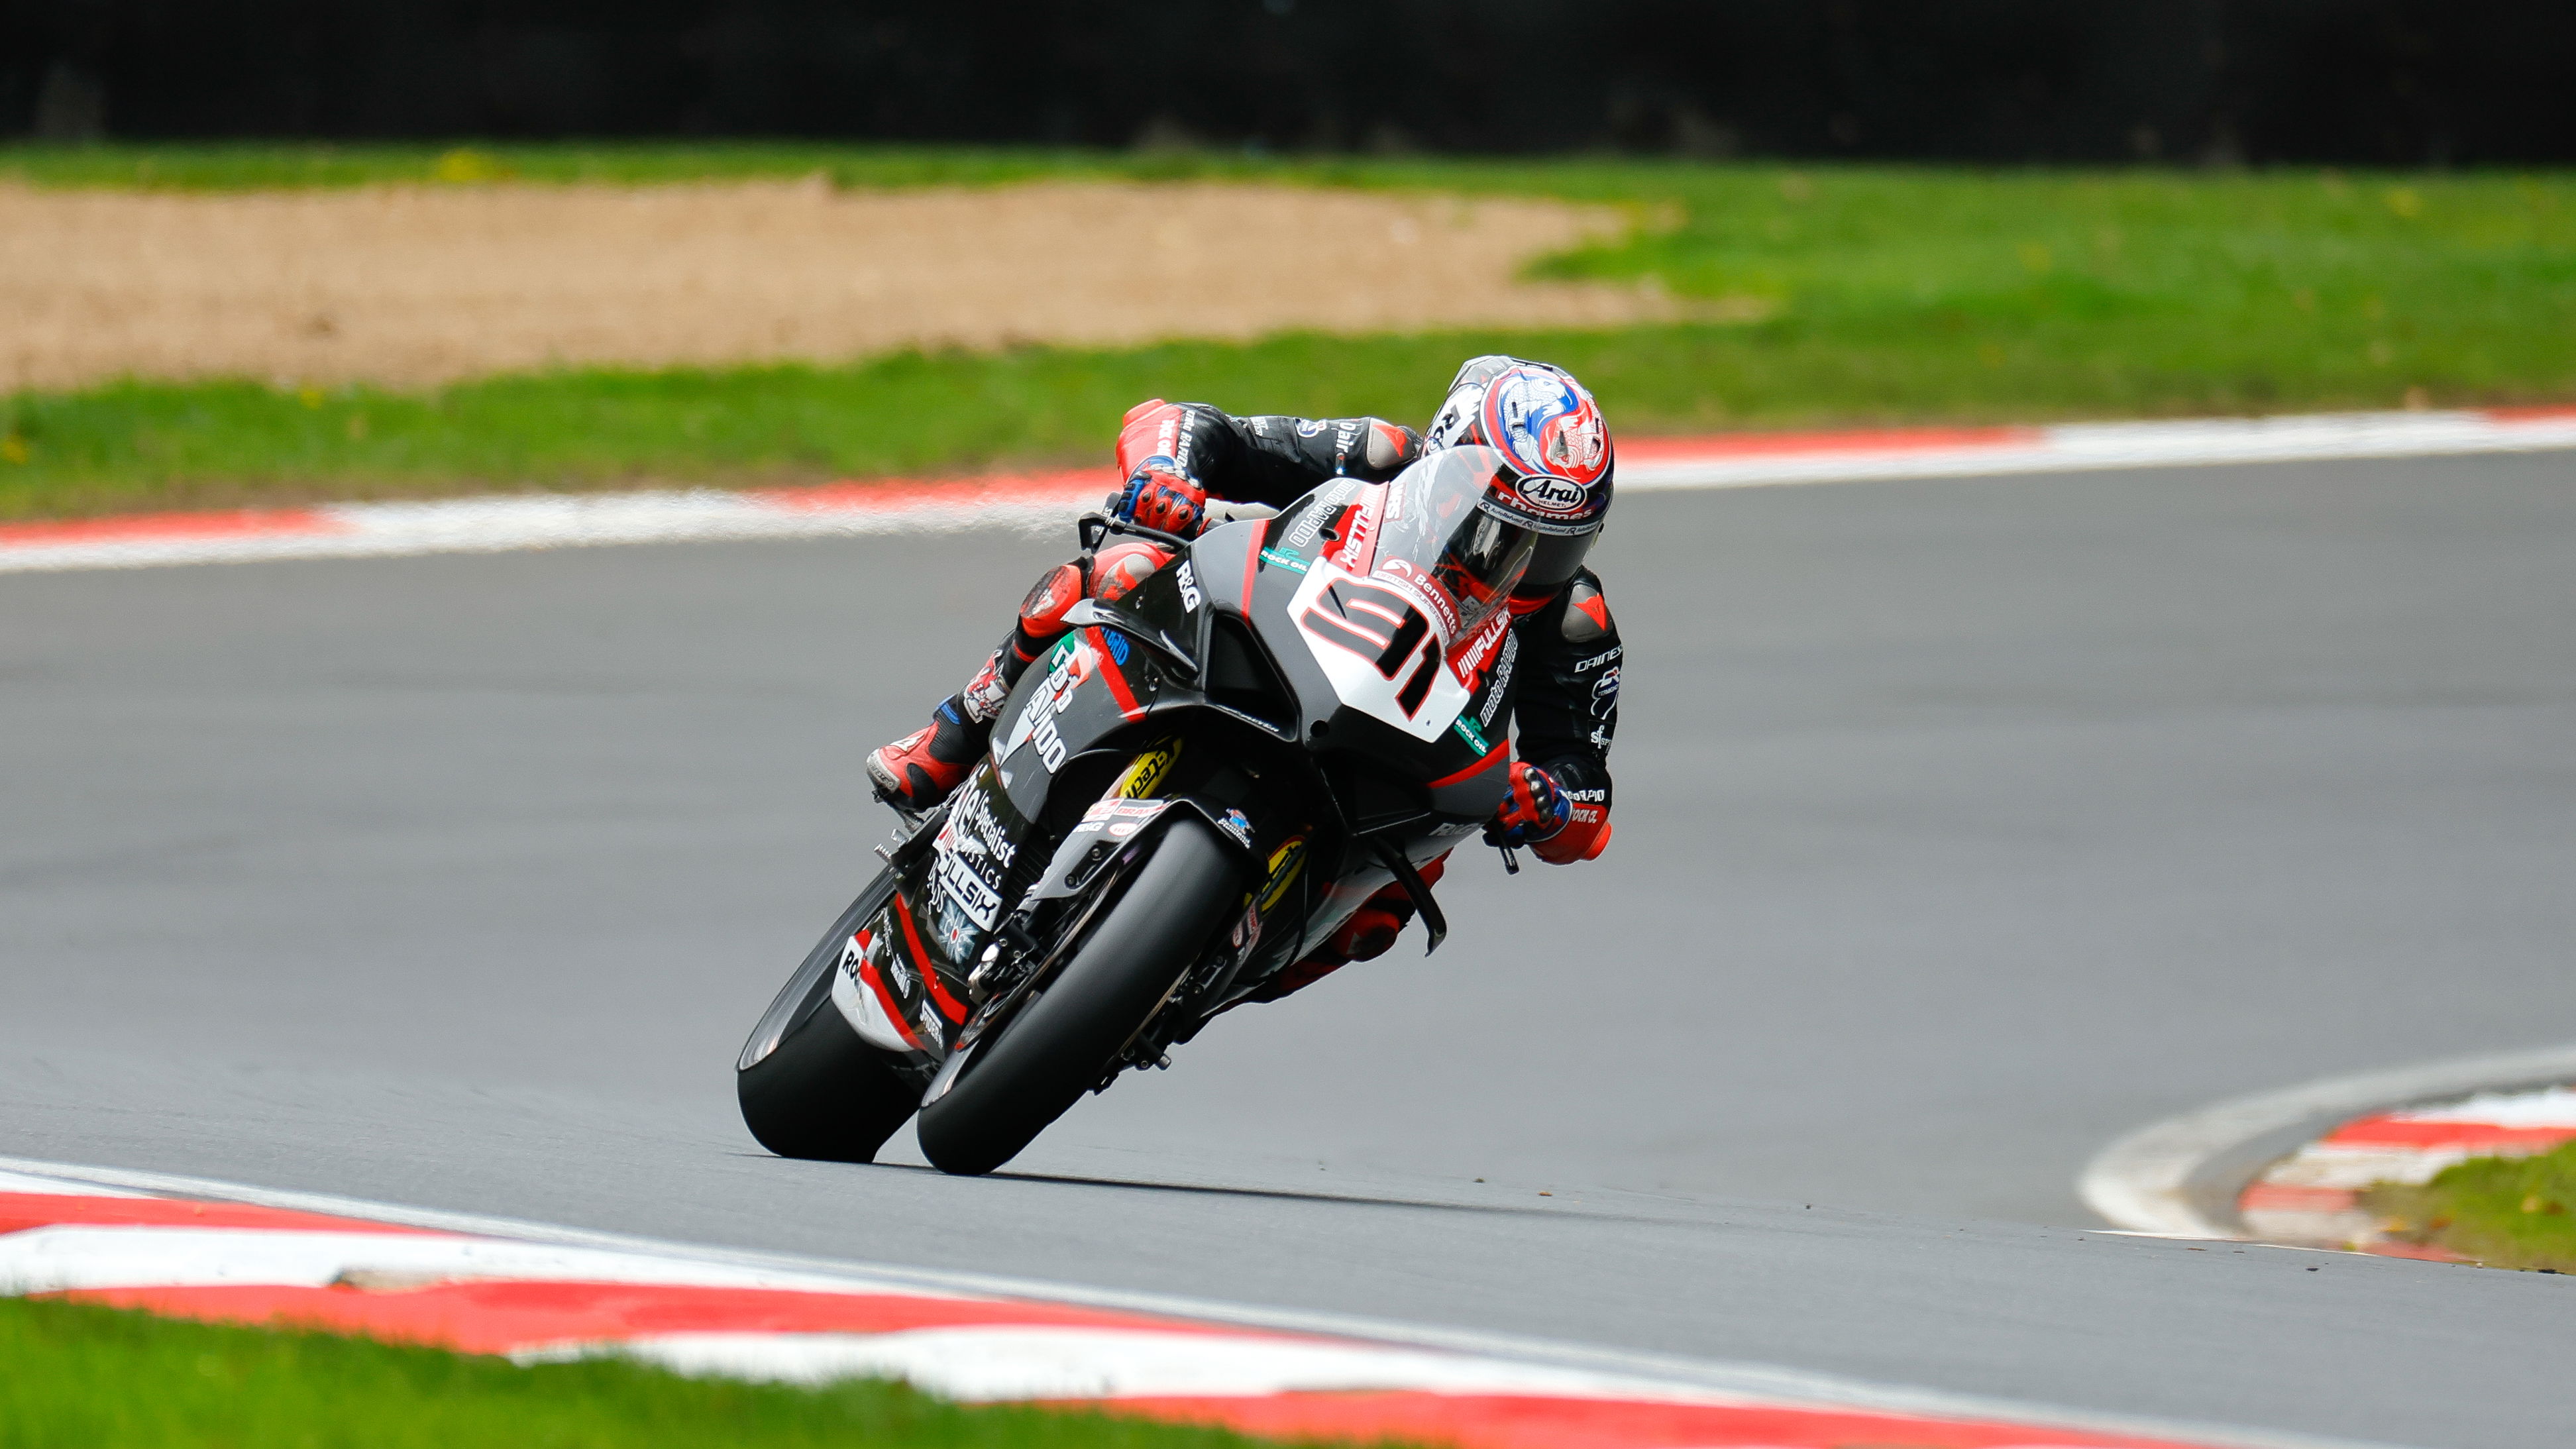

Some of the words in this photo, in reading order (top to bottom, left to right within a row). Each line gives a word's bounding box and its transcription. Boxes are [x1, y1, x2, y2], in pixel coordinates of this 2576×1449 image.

[1521, 480, 1580, 504] Arai
[1289, 500, 1336, 547] RAPIDO
[1340, 503, 1376, 568] FULLSIX
[1175, 559, 1201, 614] R&G
[1261, 550, 1293, 566] ROCK
[1290, 561, 1309, 572] OIL
[1414, 574, 1457, 634] Bennetts
[1497, 628, 1518, 688] RAPIDO
[1456, 720, 1475, 741] ROCK
[1474, 738, 1487, 753] OIL
[975, 796, 1016, 868] Specialist
